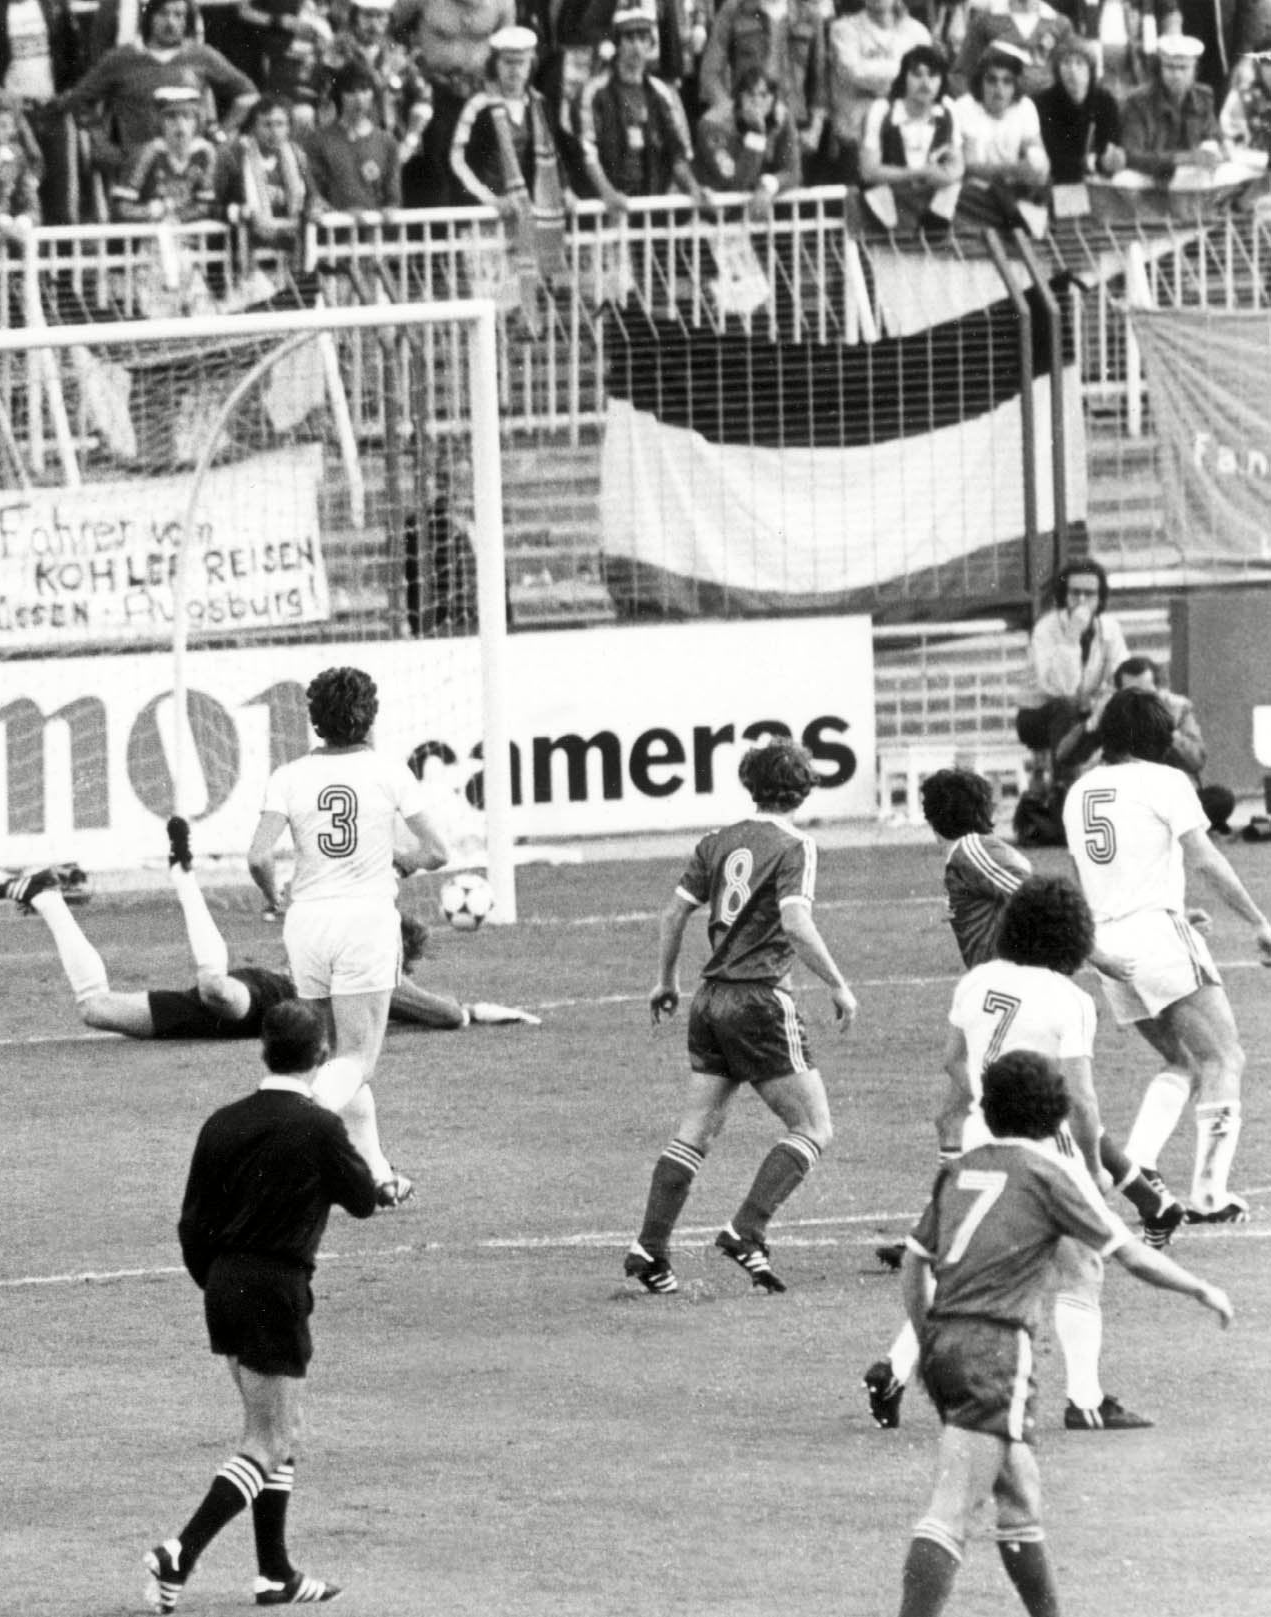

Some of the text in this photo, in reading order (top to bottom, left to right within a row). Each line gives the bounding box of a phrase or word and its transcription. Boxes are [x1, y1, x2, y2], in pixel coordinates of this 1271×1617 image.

[203, 535, 316, 586] REISEN
[317, 785, 357, 858] 3
[1081, 787, 1118, 866] 5
[720, 848, 754, 927] 8
[982, 989, 1022, 1071] 7
[944, 1169, 1009, 1265] 7
